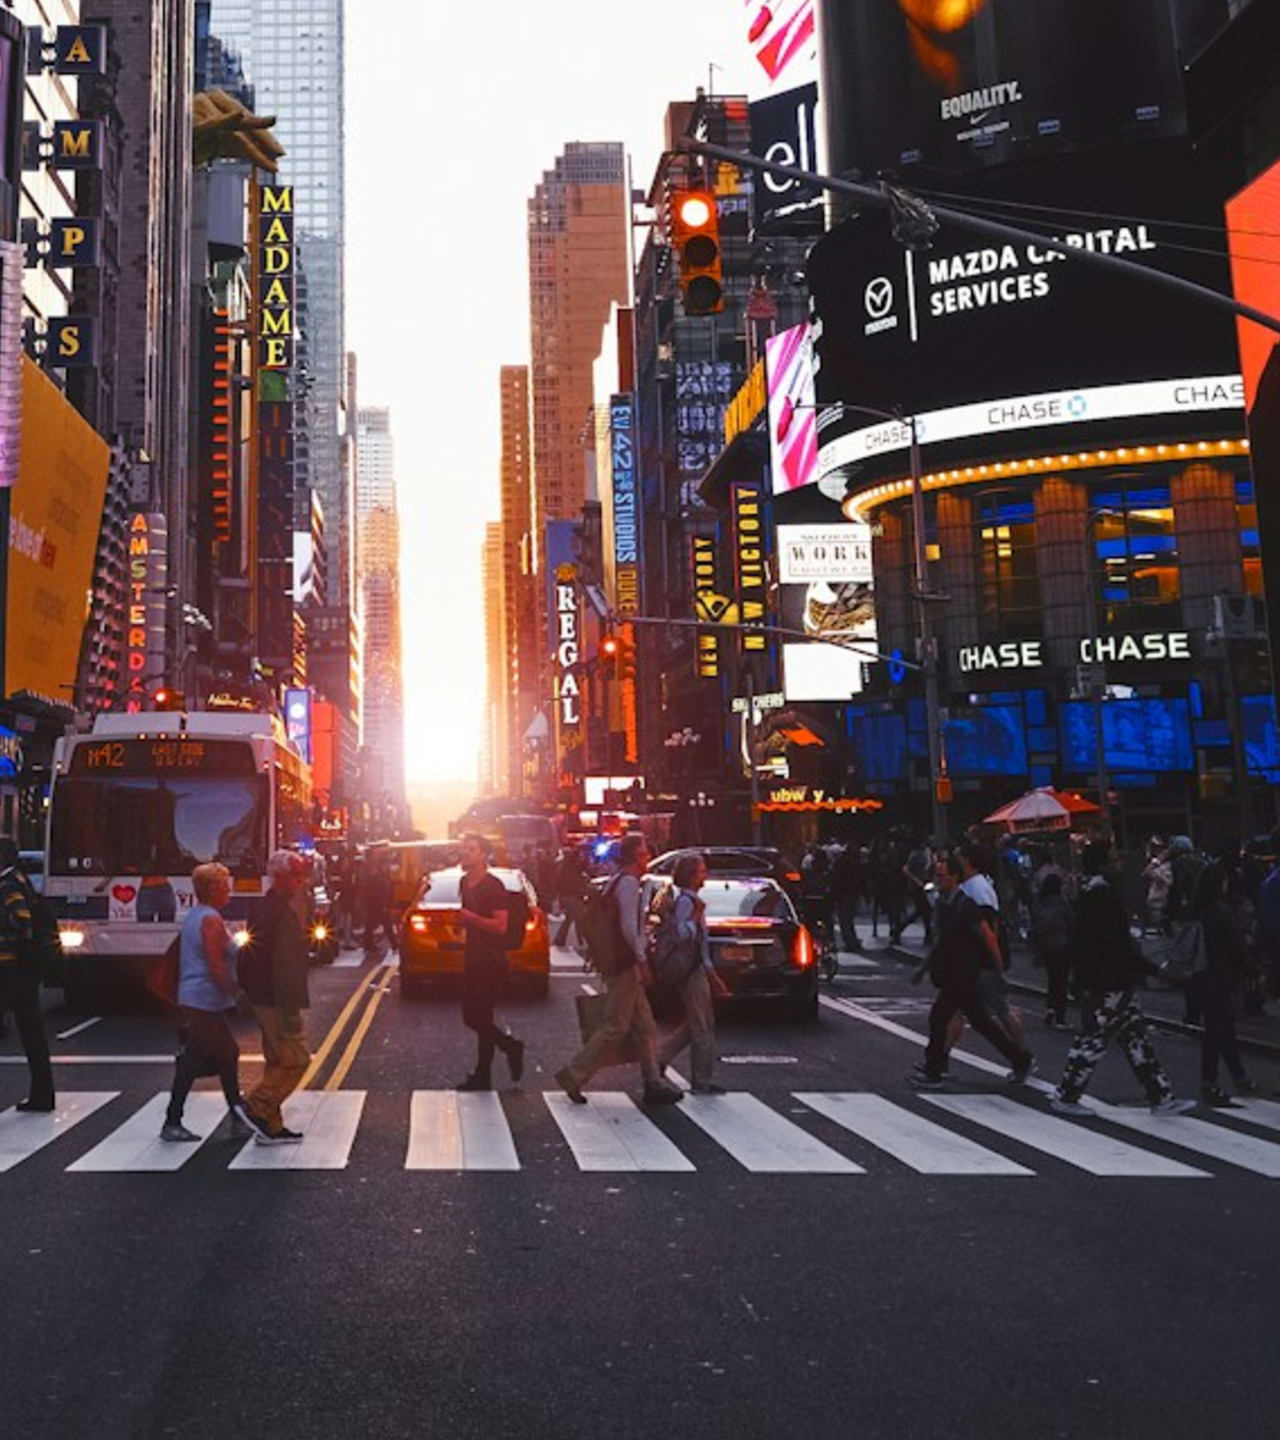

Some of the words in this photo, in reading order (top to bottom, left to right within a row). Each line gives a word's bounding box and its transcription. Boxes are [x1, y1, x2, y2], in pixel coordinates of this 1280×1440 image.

[940, 80, 1022, 120] EQUALITY.
[260, 185, 293, 368] MADAME
[928, 245, 1019, 285] MAZDA
[930, 272, 1050, 316] SERVICES
[988, 397, 1062, 426] CHASE
[1173, 382, 1244, 406] CHAS
[865, 428, 909, 453] CHASE
[614, 492, 637, 563] STUDIOS
[737, 487, 763, 588] VICTORY
[792, 545, 867, 561] WORK
[557, 584, 580, 724] REGAL
[959, 641, 1043, 672] CHASE
[1080, 632, 1191, 664] CHASE
[770, 786, 824, 803] ubwy
